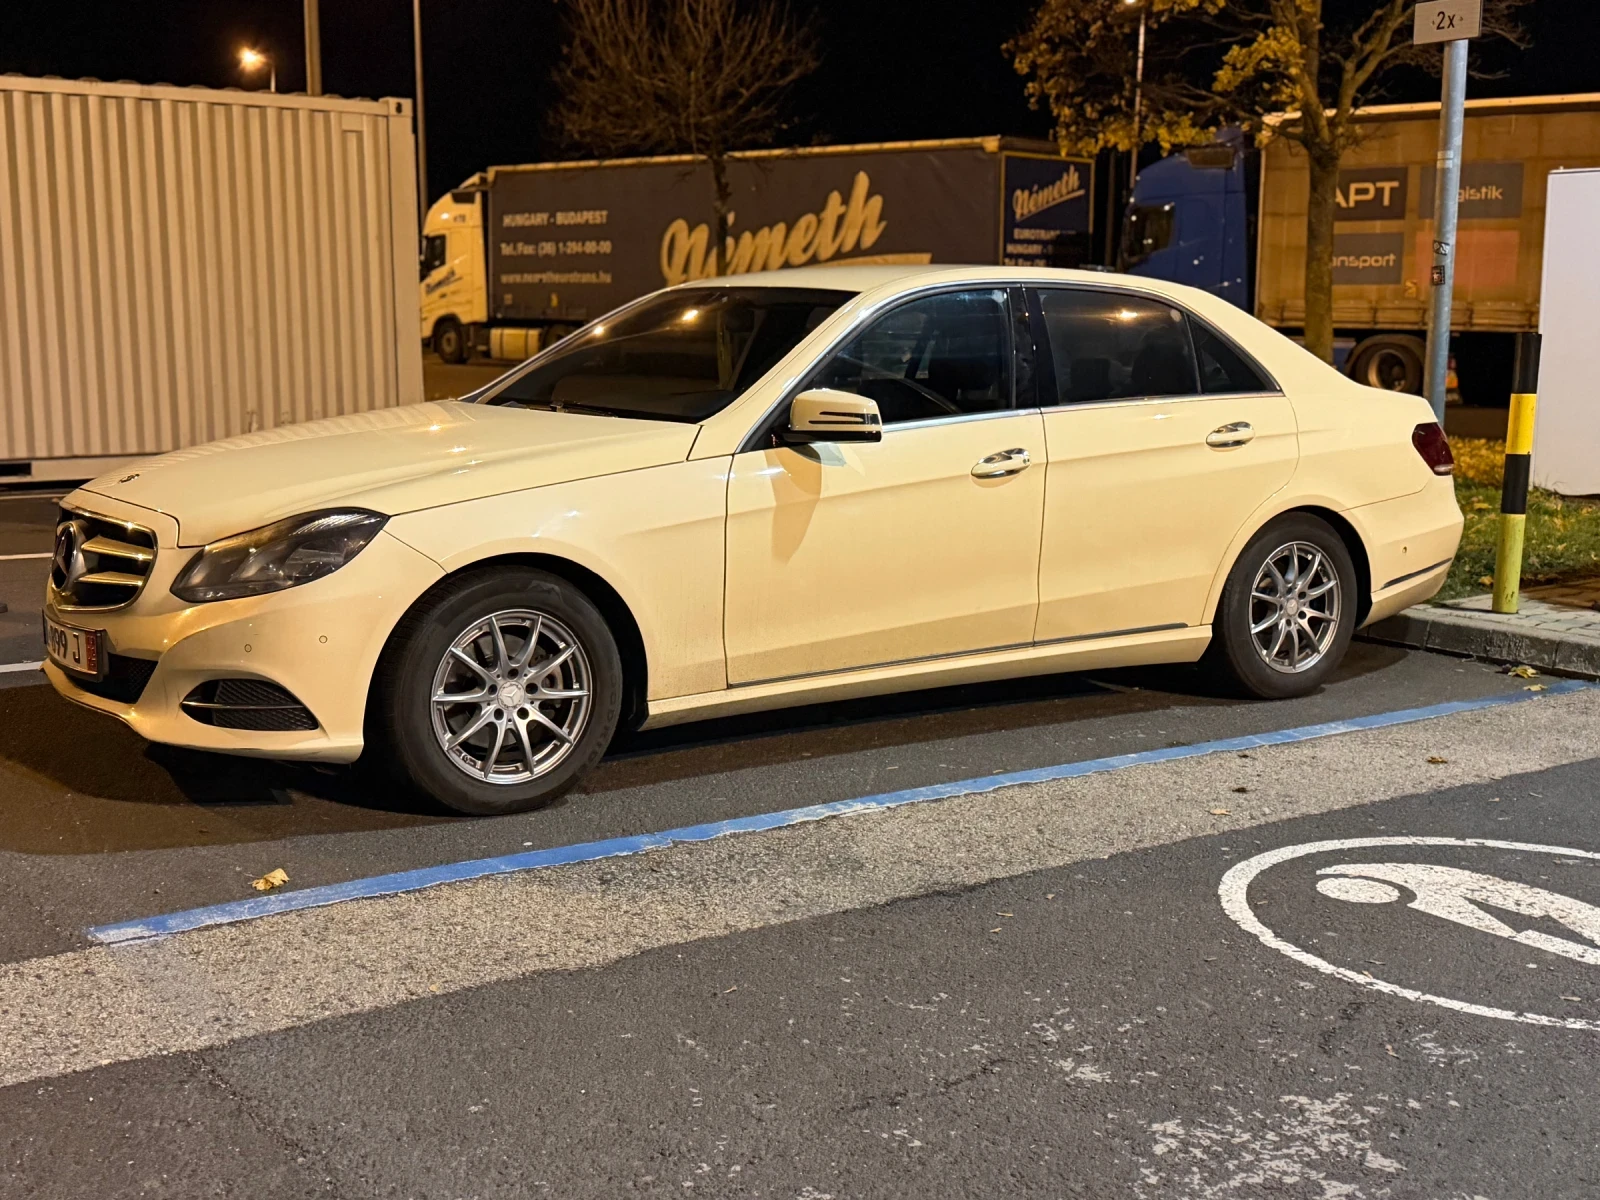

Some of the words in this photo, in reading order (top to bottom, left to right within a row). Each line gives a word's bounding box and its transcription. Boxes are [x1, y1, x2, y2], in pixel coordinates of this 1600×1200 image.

[1436, 11, 1456, 30] 2x
[1458, 185, 1504, 203] gistik
[556, 210, 608, 225] BUDAPEST
[73, 633, 81, 665] J
